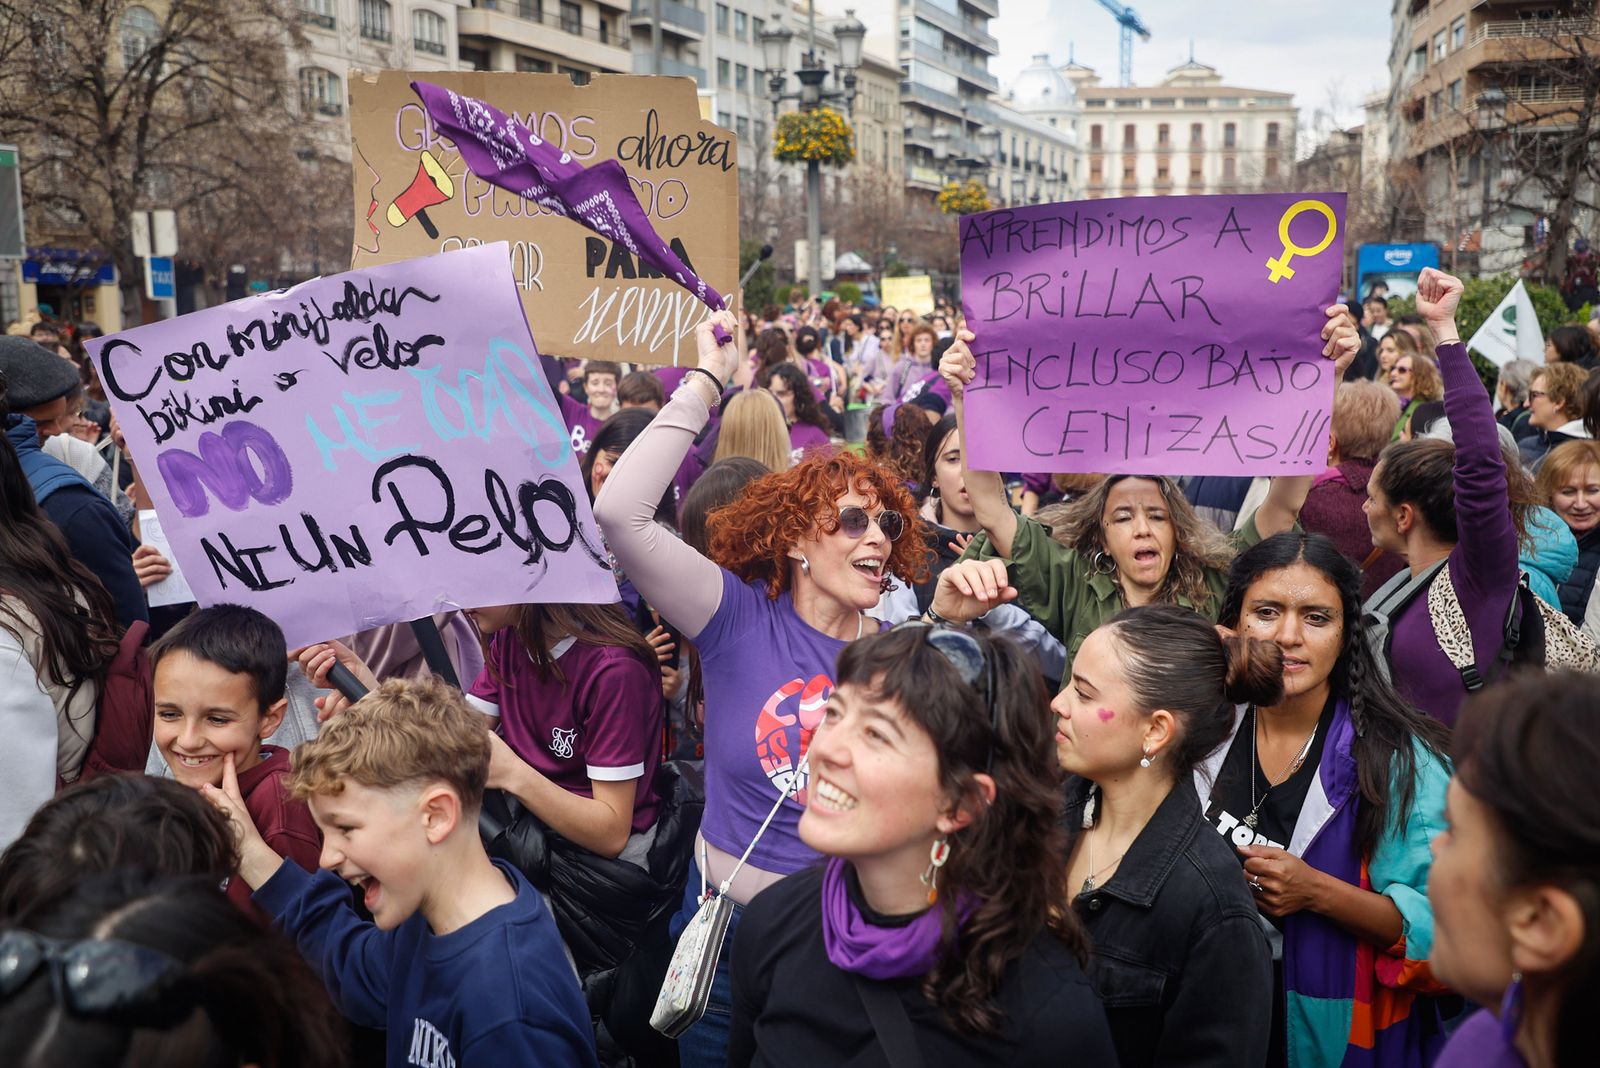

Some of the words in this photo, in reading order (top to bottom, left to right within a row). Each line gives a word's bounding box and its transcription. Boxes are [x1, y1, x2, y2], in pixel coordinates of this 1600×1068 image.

[617, 108, 736, 173] ahora
[1214, 207, 1253, 254] A
[100, 338, 231, 402] Con
[966, 342, 1184, 396] INCLUSO
[1192, 343, 1321, 395] BAJO
[156, 420, 294, 518] NO
[304, 391, 422, 471] ME
[200, 532, 296, 592] NI
[278, 512, 375, 574] UN
